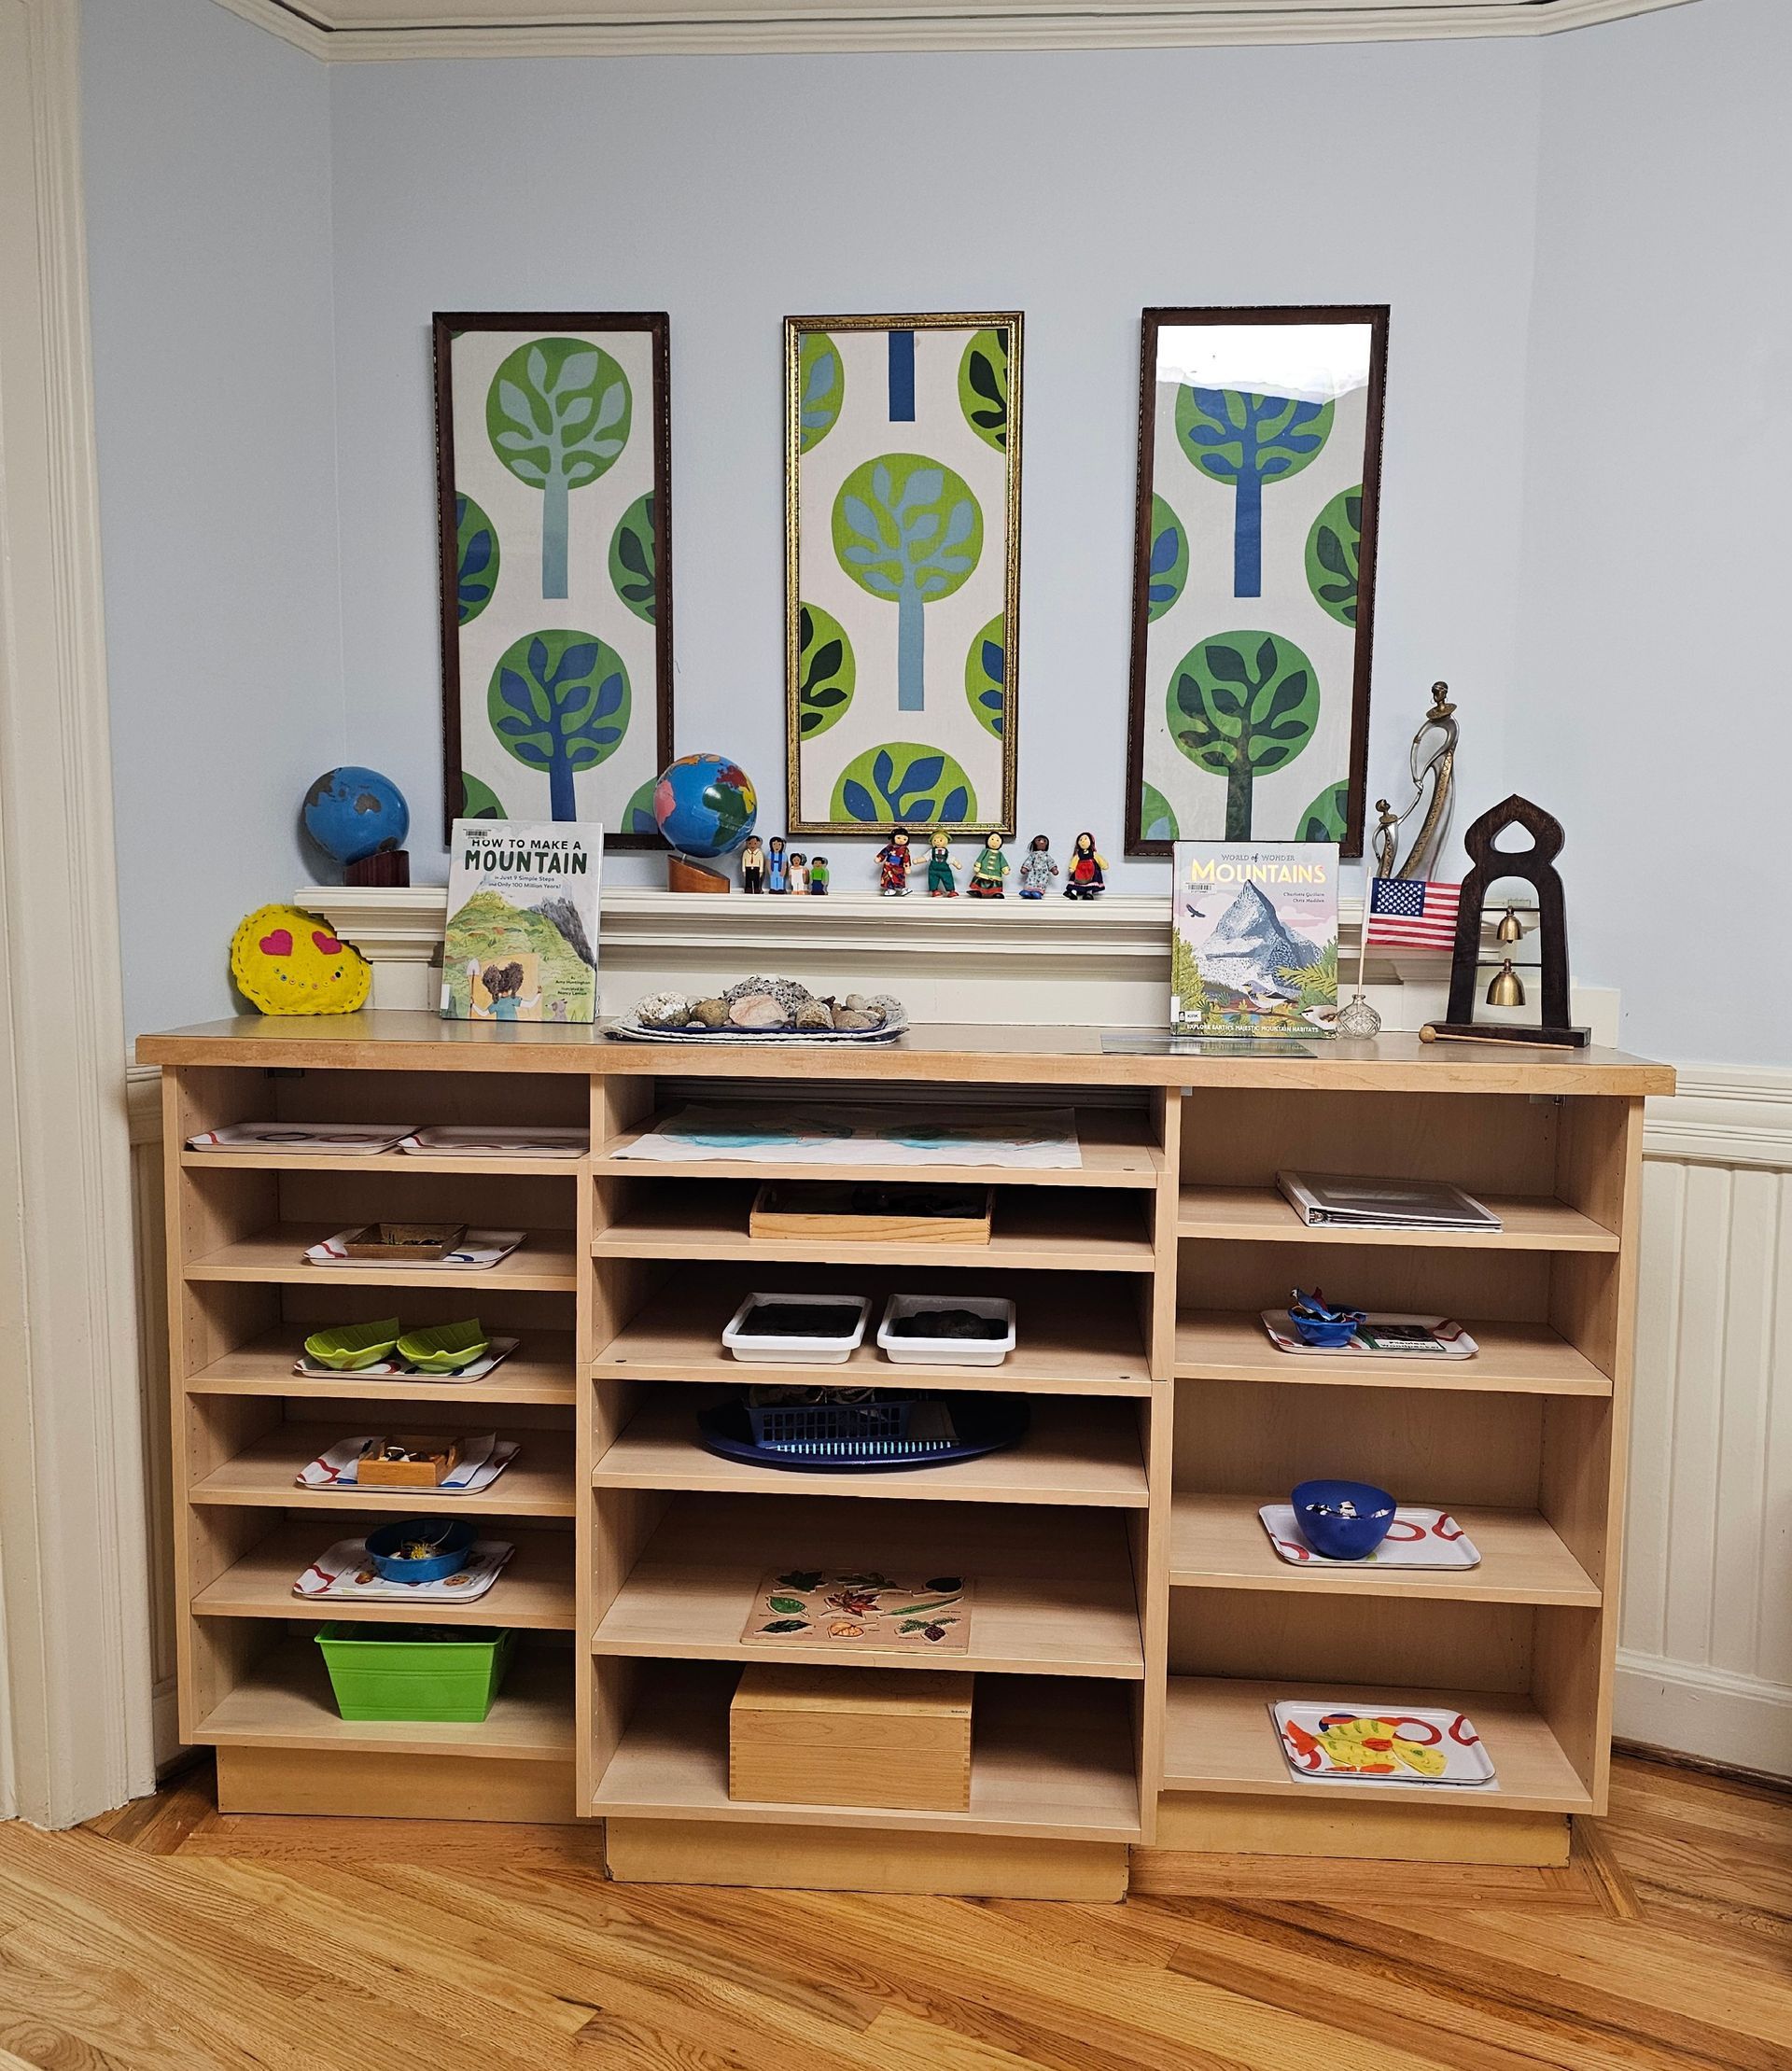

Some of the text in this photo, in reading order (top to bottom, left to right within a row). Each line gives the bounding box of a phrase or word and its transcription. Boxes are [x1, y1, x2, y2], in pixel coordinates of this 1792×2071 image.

[471, 839, 581, 850] HOW TO MAKE A
[465, 849, 587, 875] MOUNTAIN
[1251, 853, 1259, 862] of
[1186, 1023, 1211, 1031] EXPLORE
